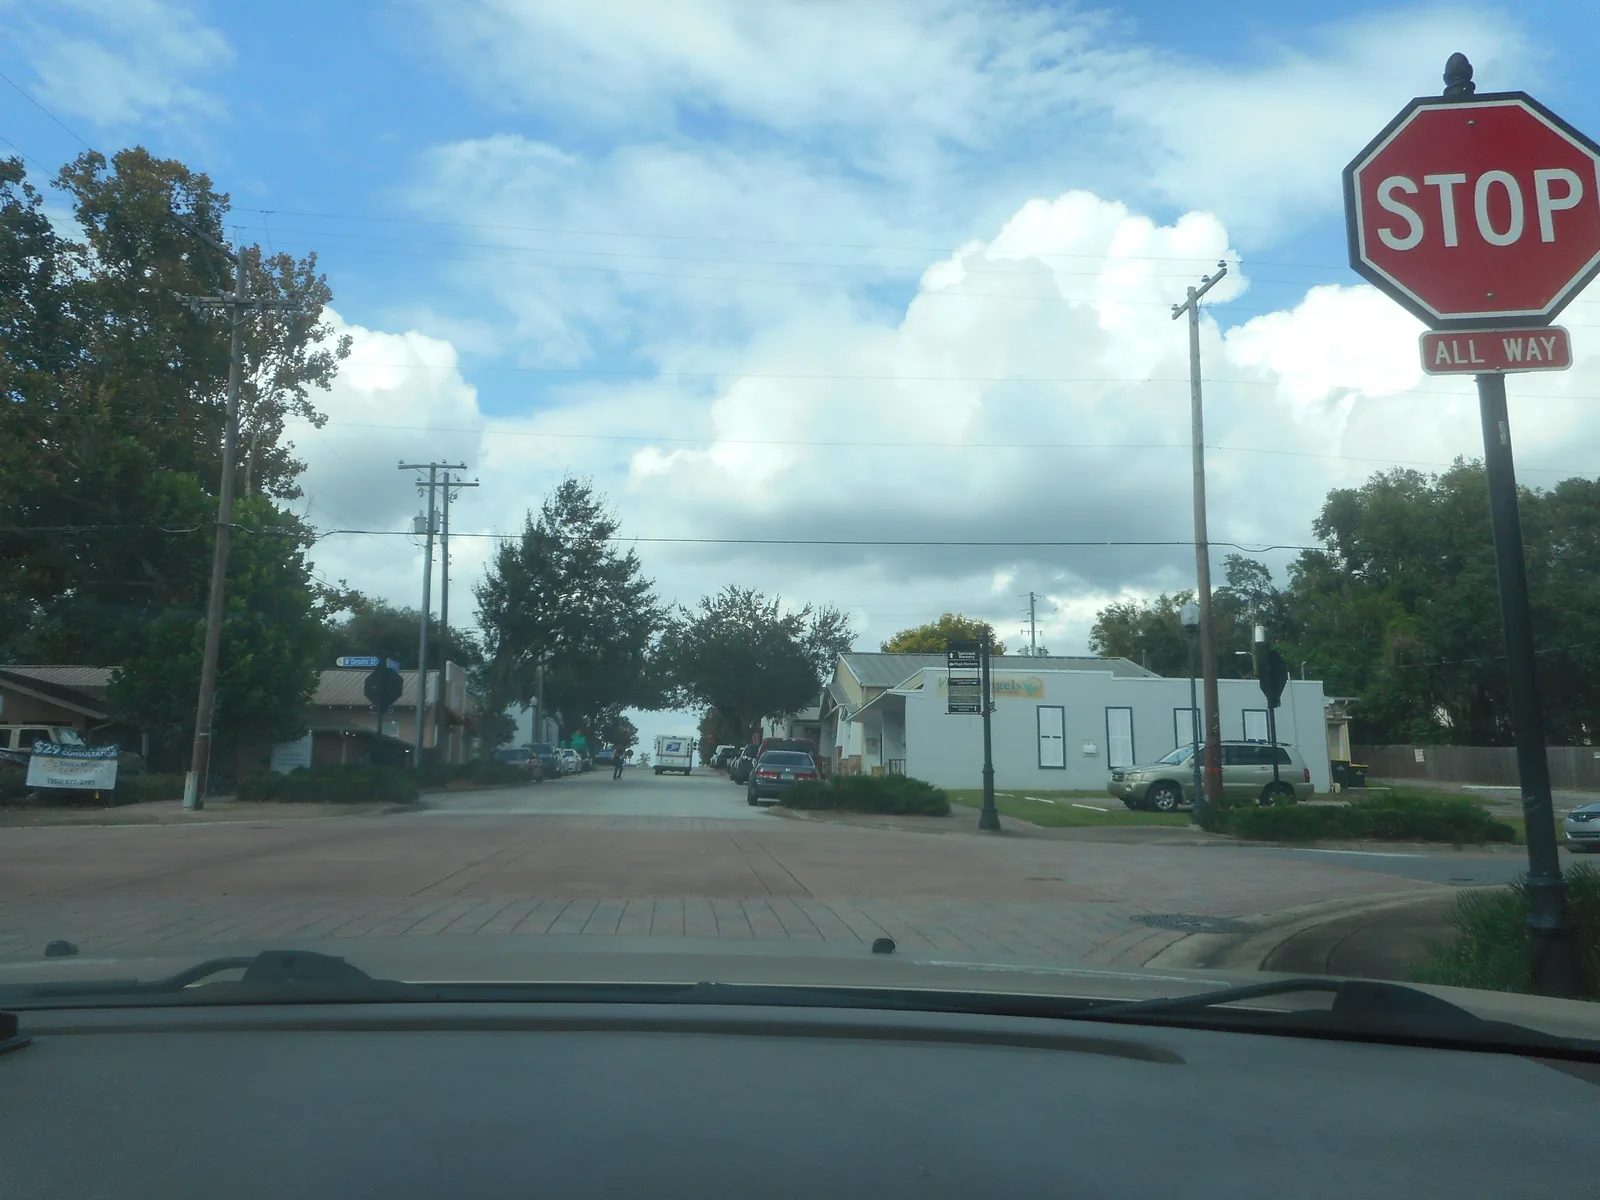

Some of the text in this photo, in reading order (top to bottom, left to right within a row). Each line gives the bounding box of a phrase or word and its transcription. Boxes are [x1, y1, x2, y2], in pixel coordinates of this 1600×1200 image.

[1376, 168, 1584, 251] STOP
[1435, 336, 1557, 365] ALL WAY
[34, 741, 60, 754] $29
